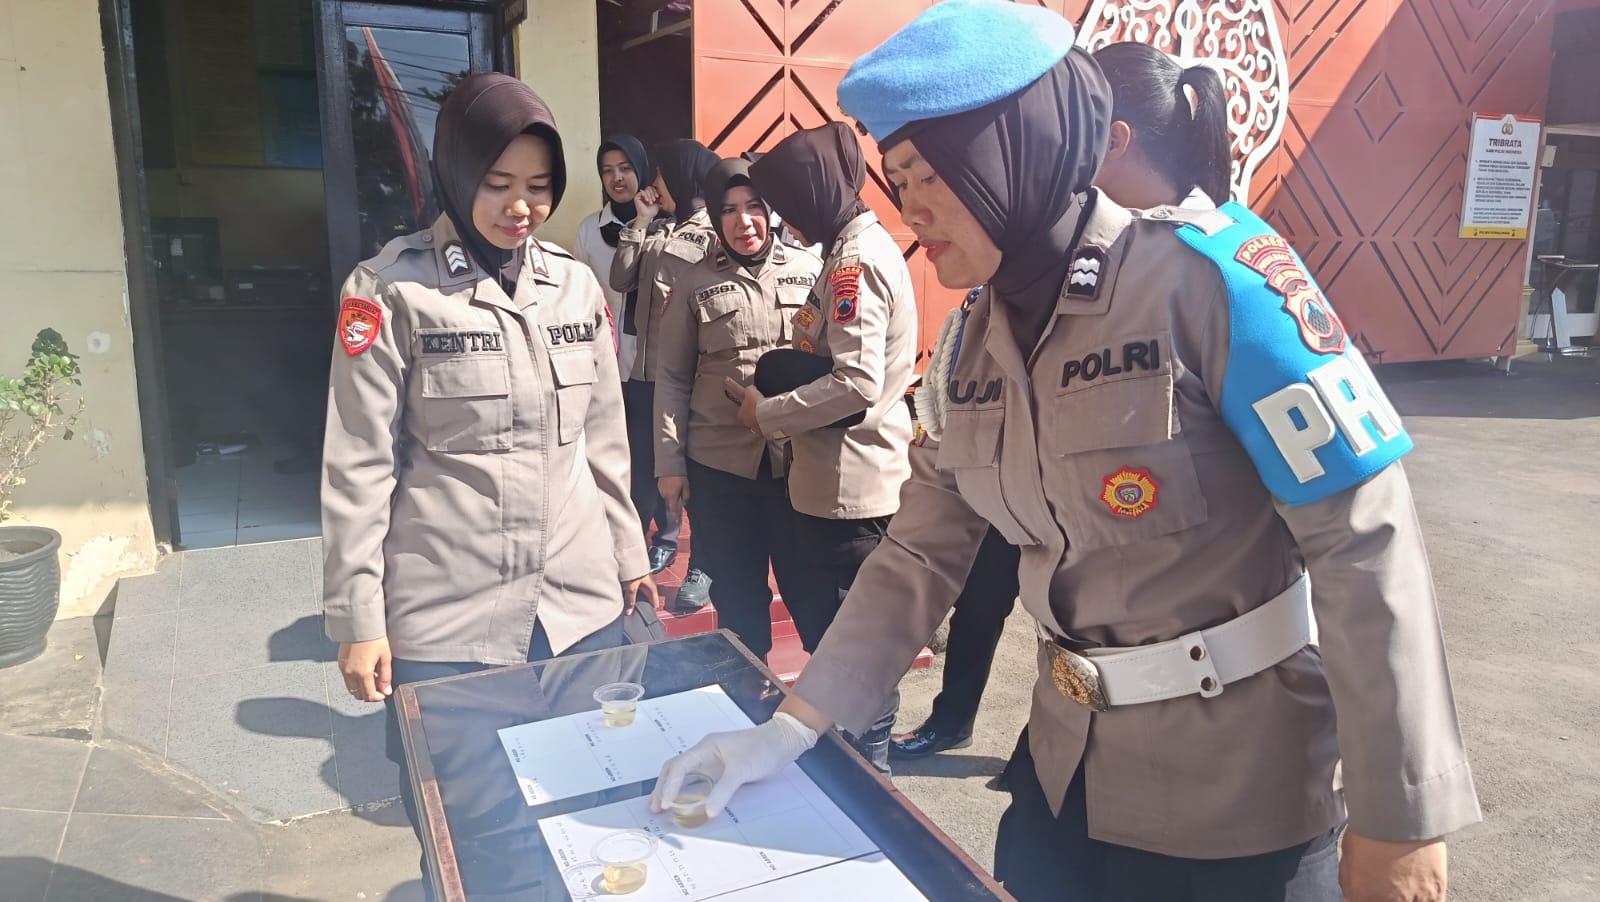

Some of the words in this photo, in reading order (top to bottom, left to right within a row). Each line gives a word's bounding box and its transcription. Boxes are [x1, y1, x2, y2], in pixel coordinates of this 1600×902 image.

[1488, 138, 1522, 148] TRIBRATA
[1241, 236, 1286, 261] POLRES
[777, 276, 813, 287] POLRI
[421, 331, 503, 354] KENTRI
[1061, 340, 1160, 387] POLRI
[1251, 347, 1402, 484] PR
